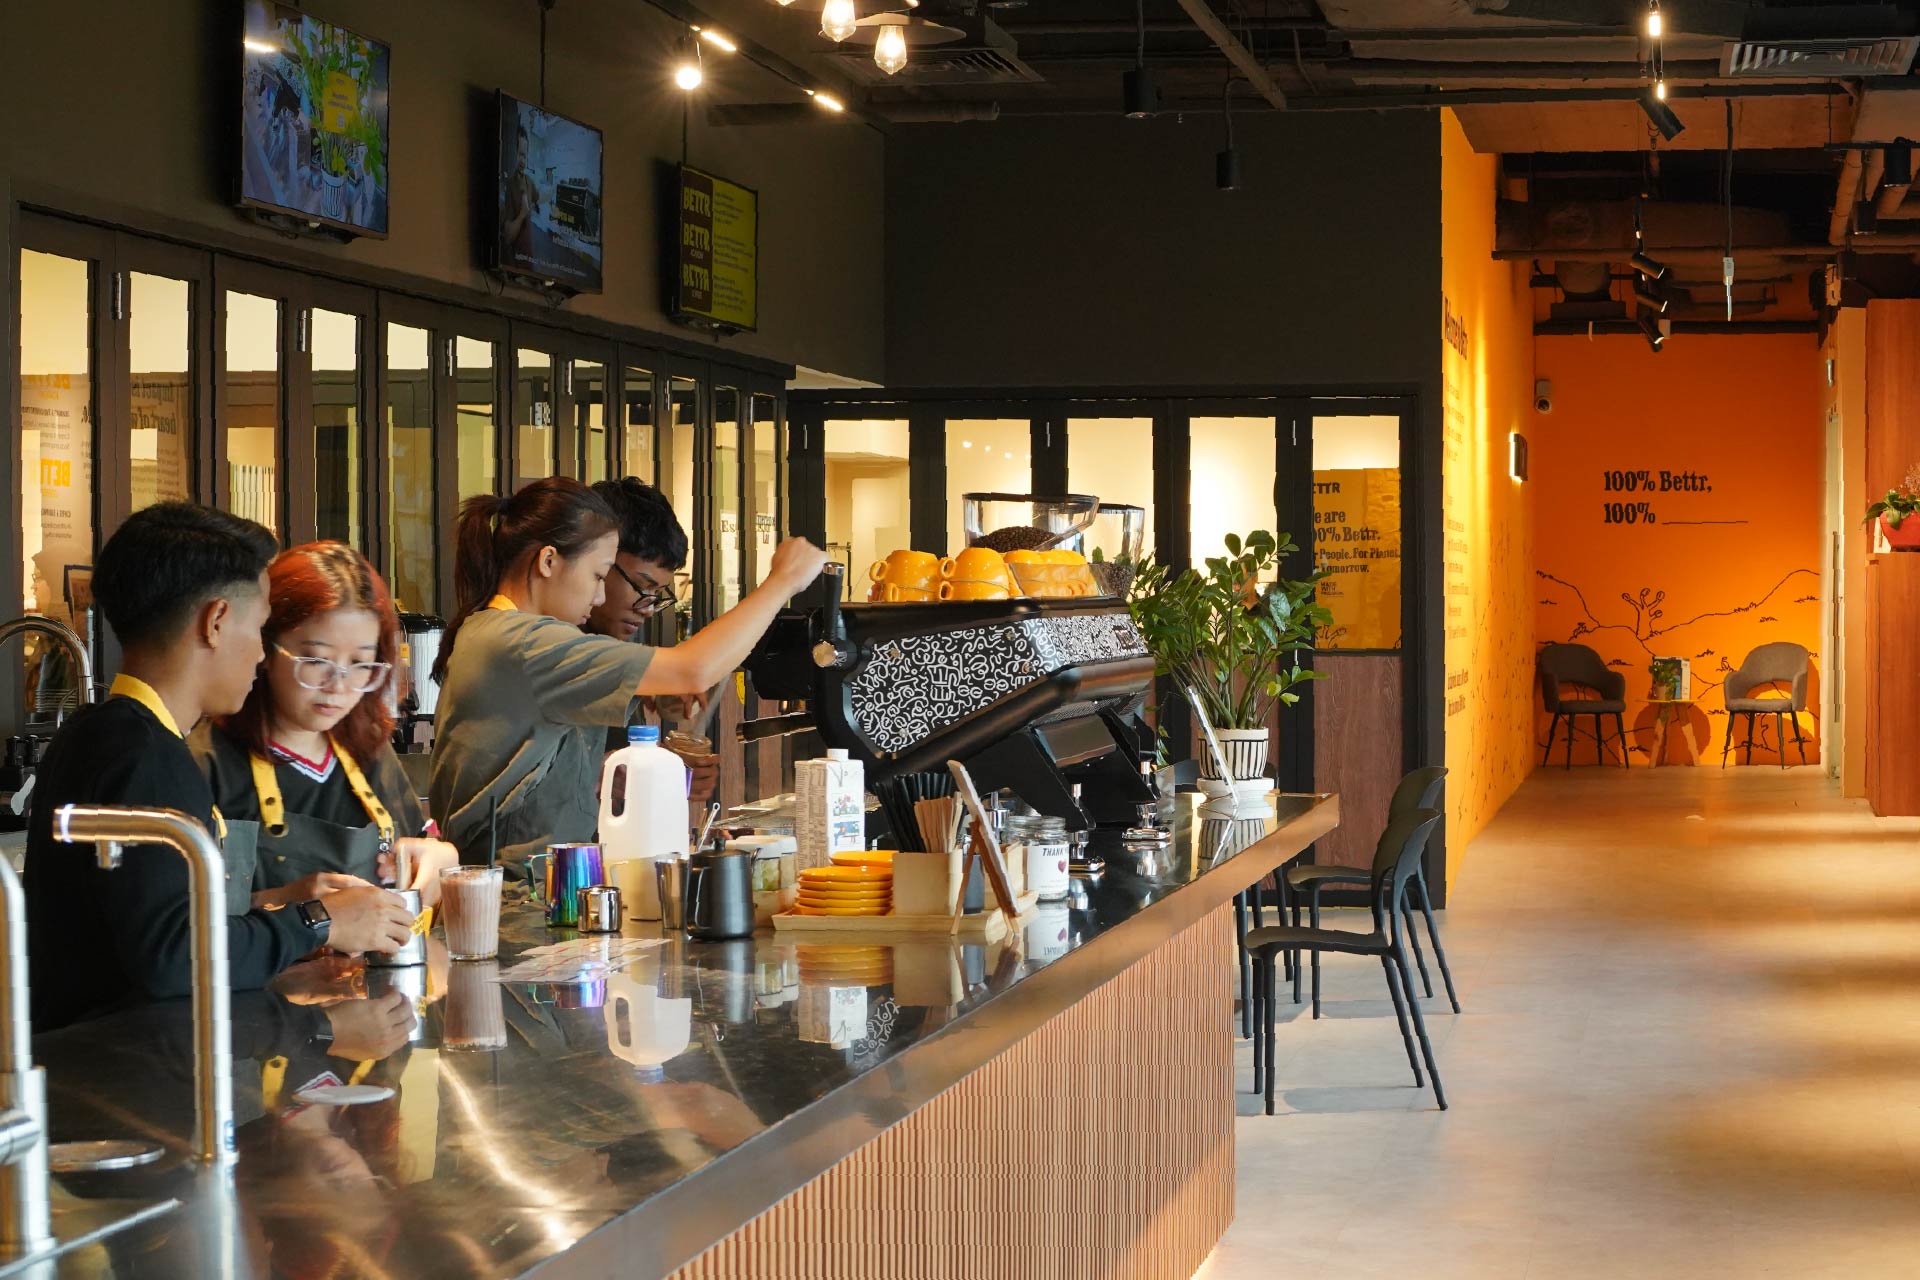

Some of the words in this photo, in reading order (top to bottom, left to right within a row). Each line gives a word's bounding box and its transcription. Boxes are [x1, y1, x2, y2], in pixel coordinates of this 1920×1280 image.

[1603, 470, 1656, 492] 100%
[1659, 470, 1712, 494] Bettr,
[1324, 510, 1346, 524] are
[1603, 502, 1656, 524] 100%
[1343, 526, 1381, 542] Bettr.
[1353, 547, 1369, 559] For
